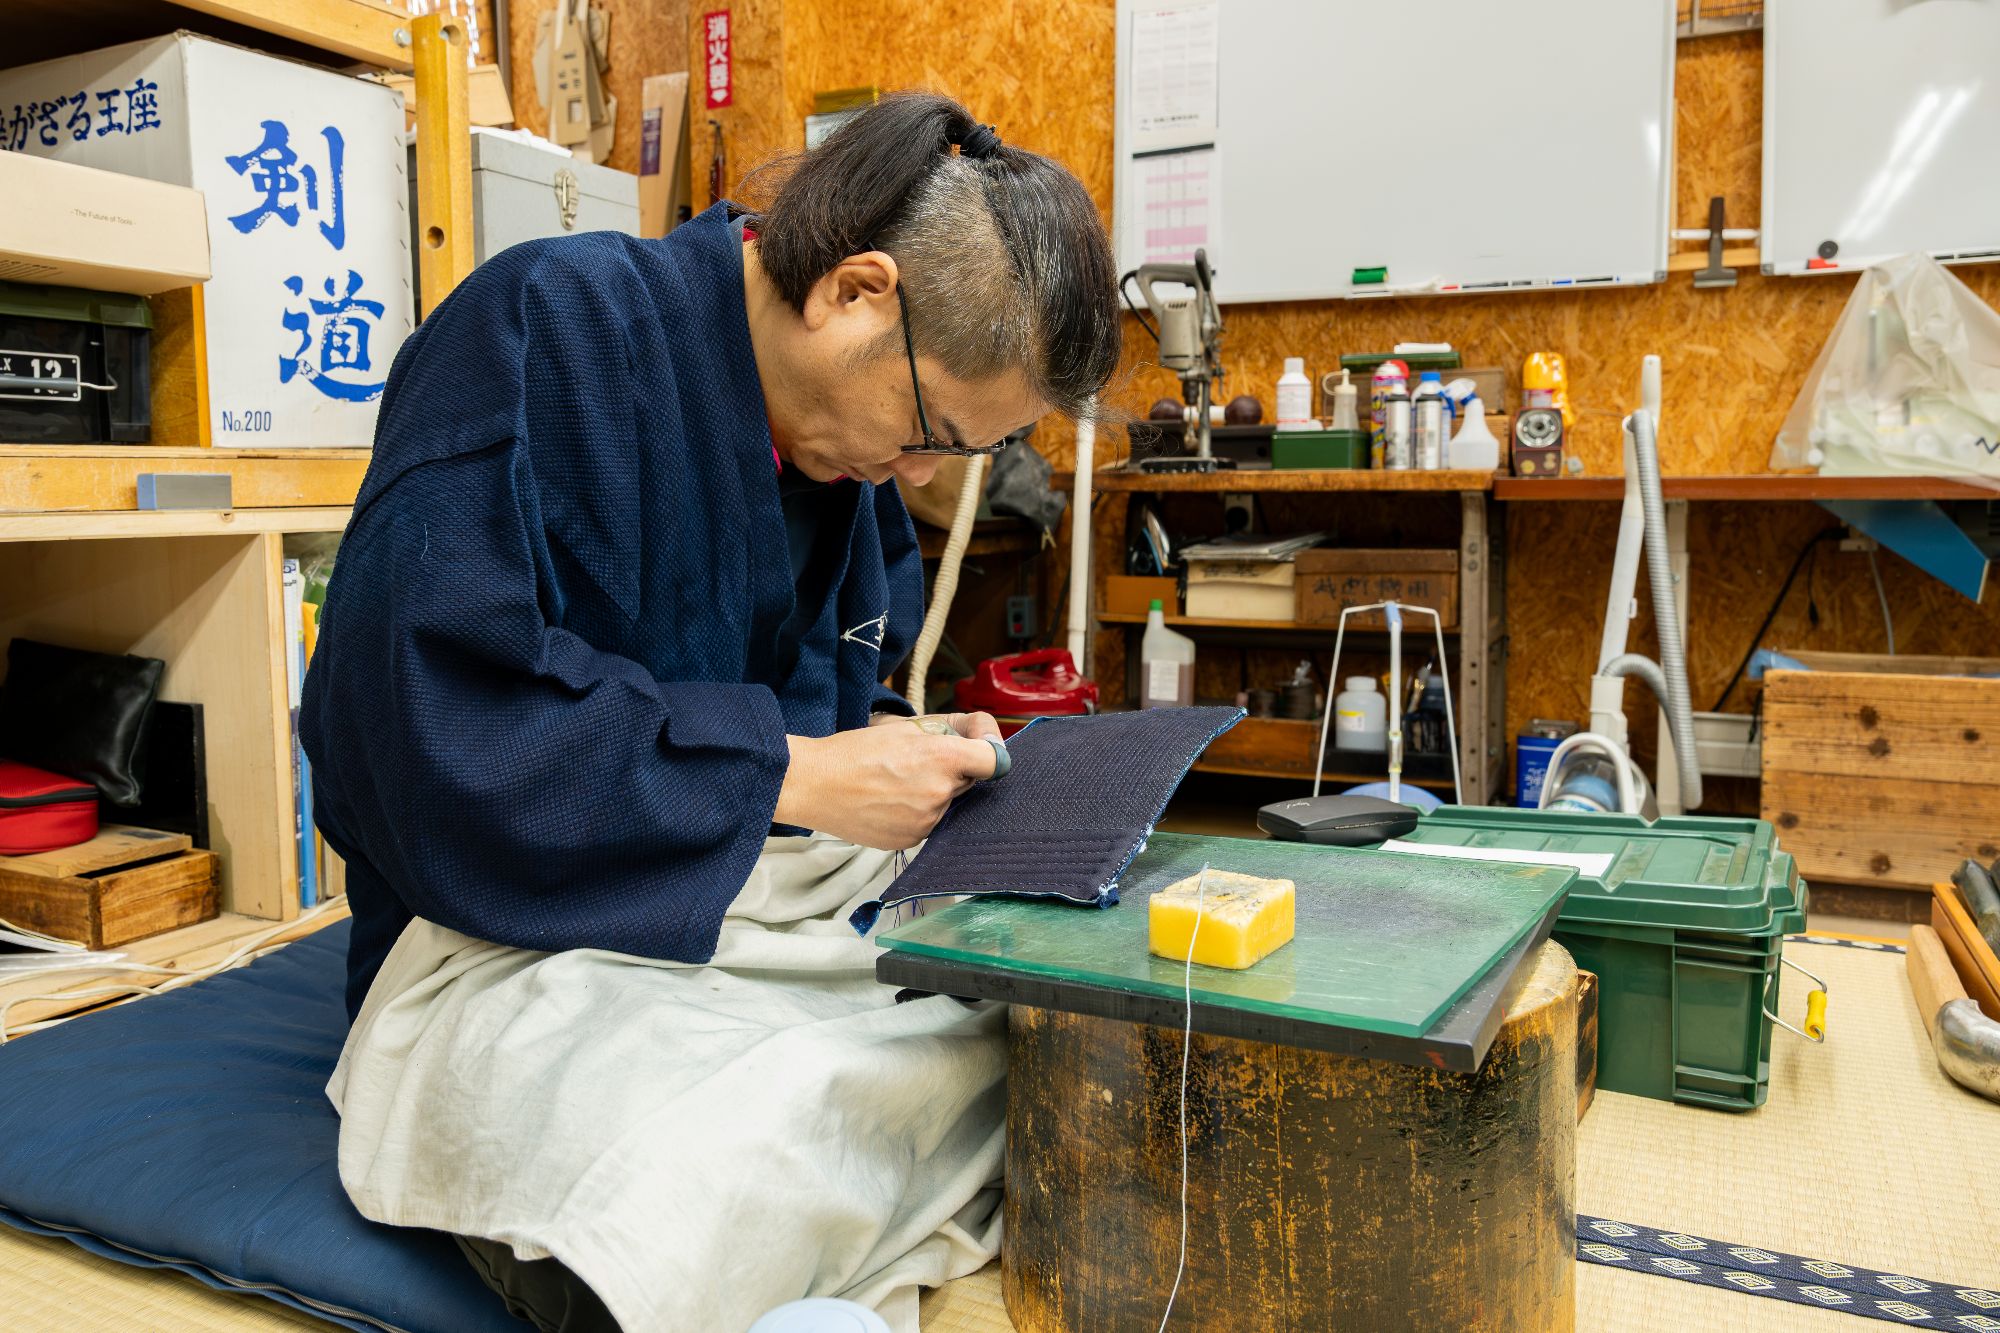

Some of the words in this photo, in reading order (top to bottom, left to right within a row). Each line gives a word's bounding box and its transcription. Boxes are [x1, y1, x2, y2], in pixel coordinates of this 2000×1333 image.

[708, 15, 728, 89] 消火器
[222, 410, 271, 431] No.200
